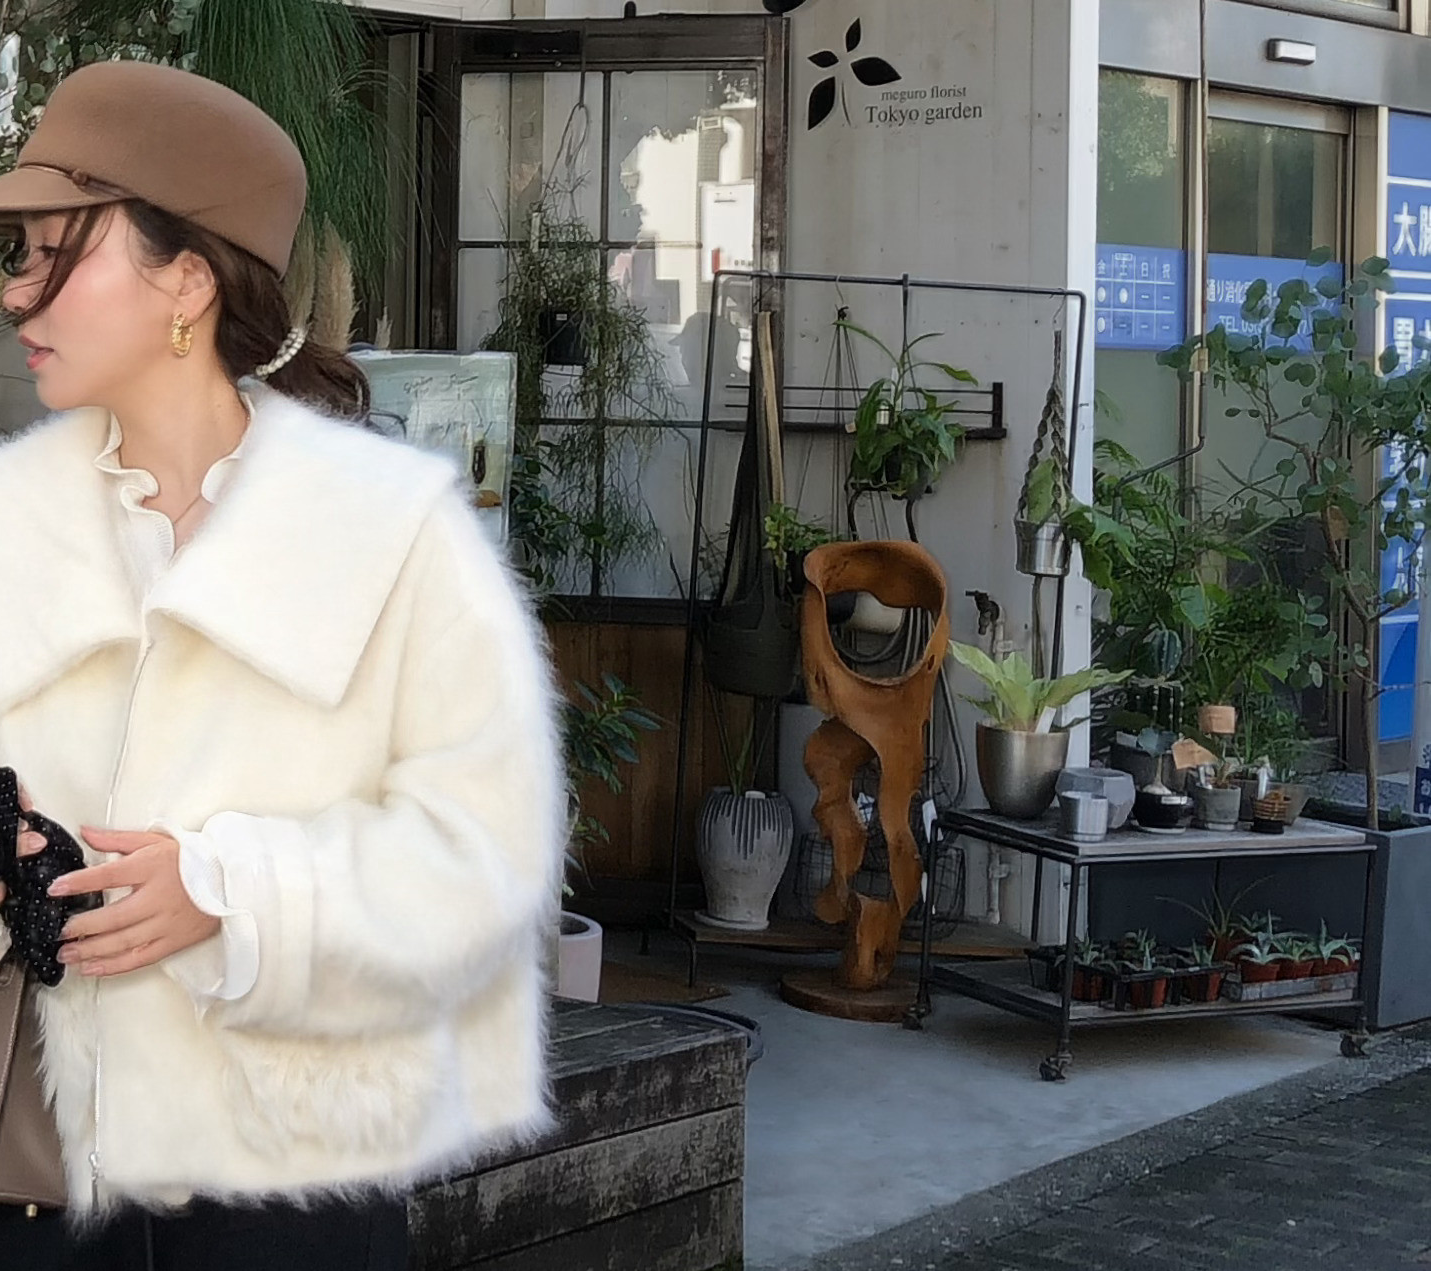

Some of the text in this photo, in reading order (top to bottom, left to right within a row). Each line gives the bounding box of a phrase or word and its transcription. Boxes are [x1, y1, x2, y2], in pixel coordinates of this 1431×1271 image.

[881, 85, 967, 104] meguro florist
[865, 102, 983, 127] Tokyo garden
